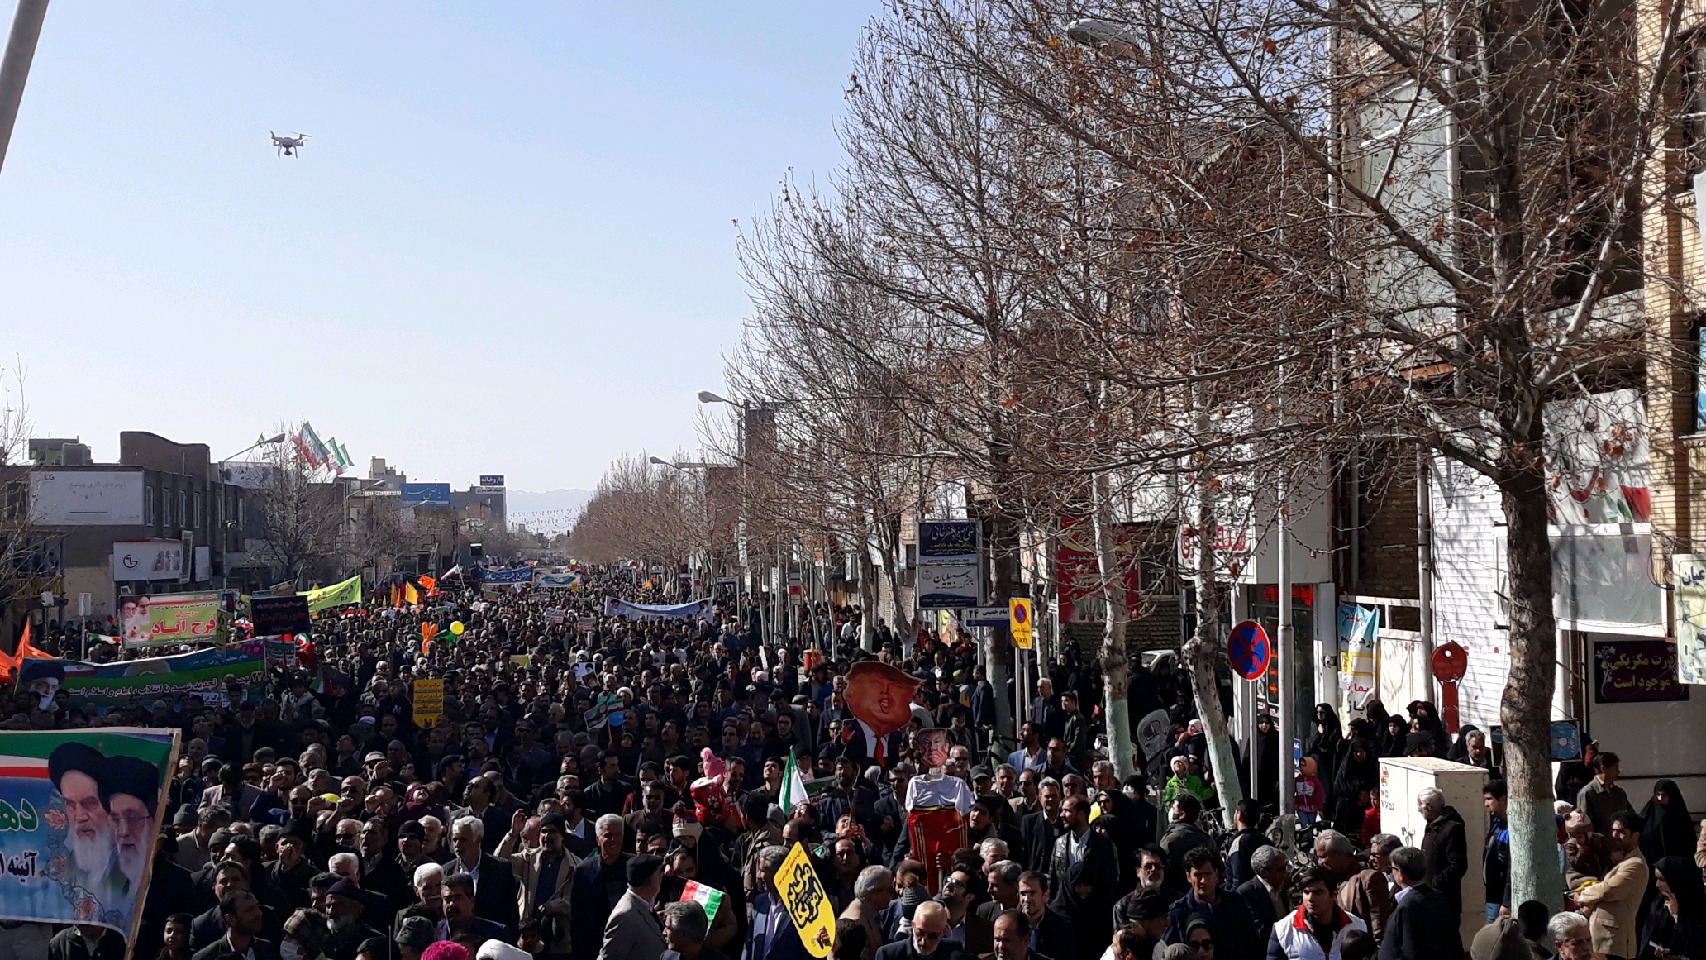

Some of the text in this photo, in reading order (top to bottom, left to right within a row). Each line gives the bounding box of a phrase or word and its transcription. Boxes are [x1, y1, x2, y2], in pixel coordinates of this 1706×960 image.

[152, 617, 187, 636] آباد
[1609, 653, 1649, 670] مکزیکی
[1613, 675, 1671, 691] موجود است
[0, 798, 38, 832] ده
